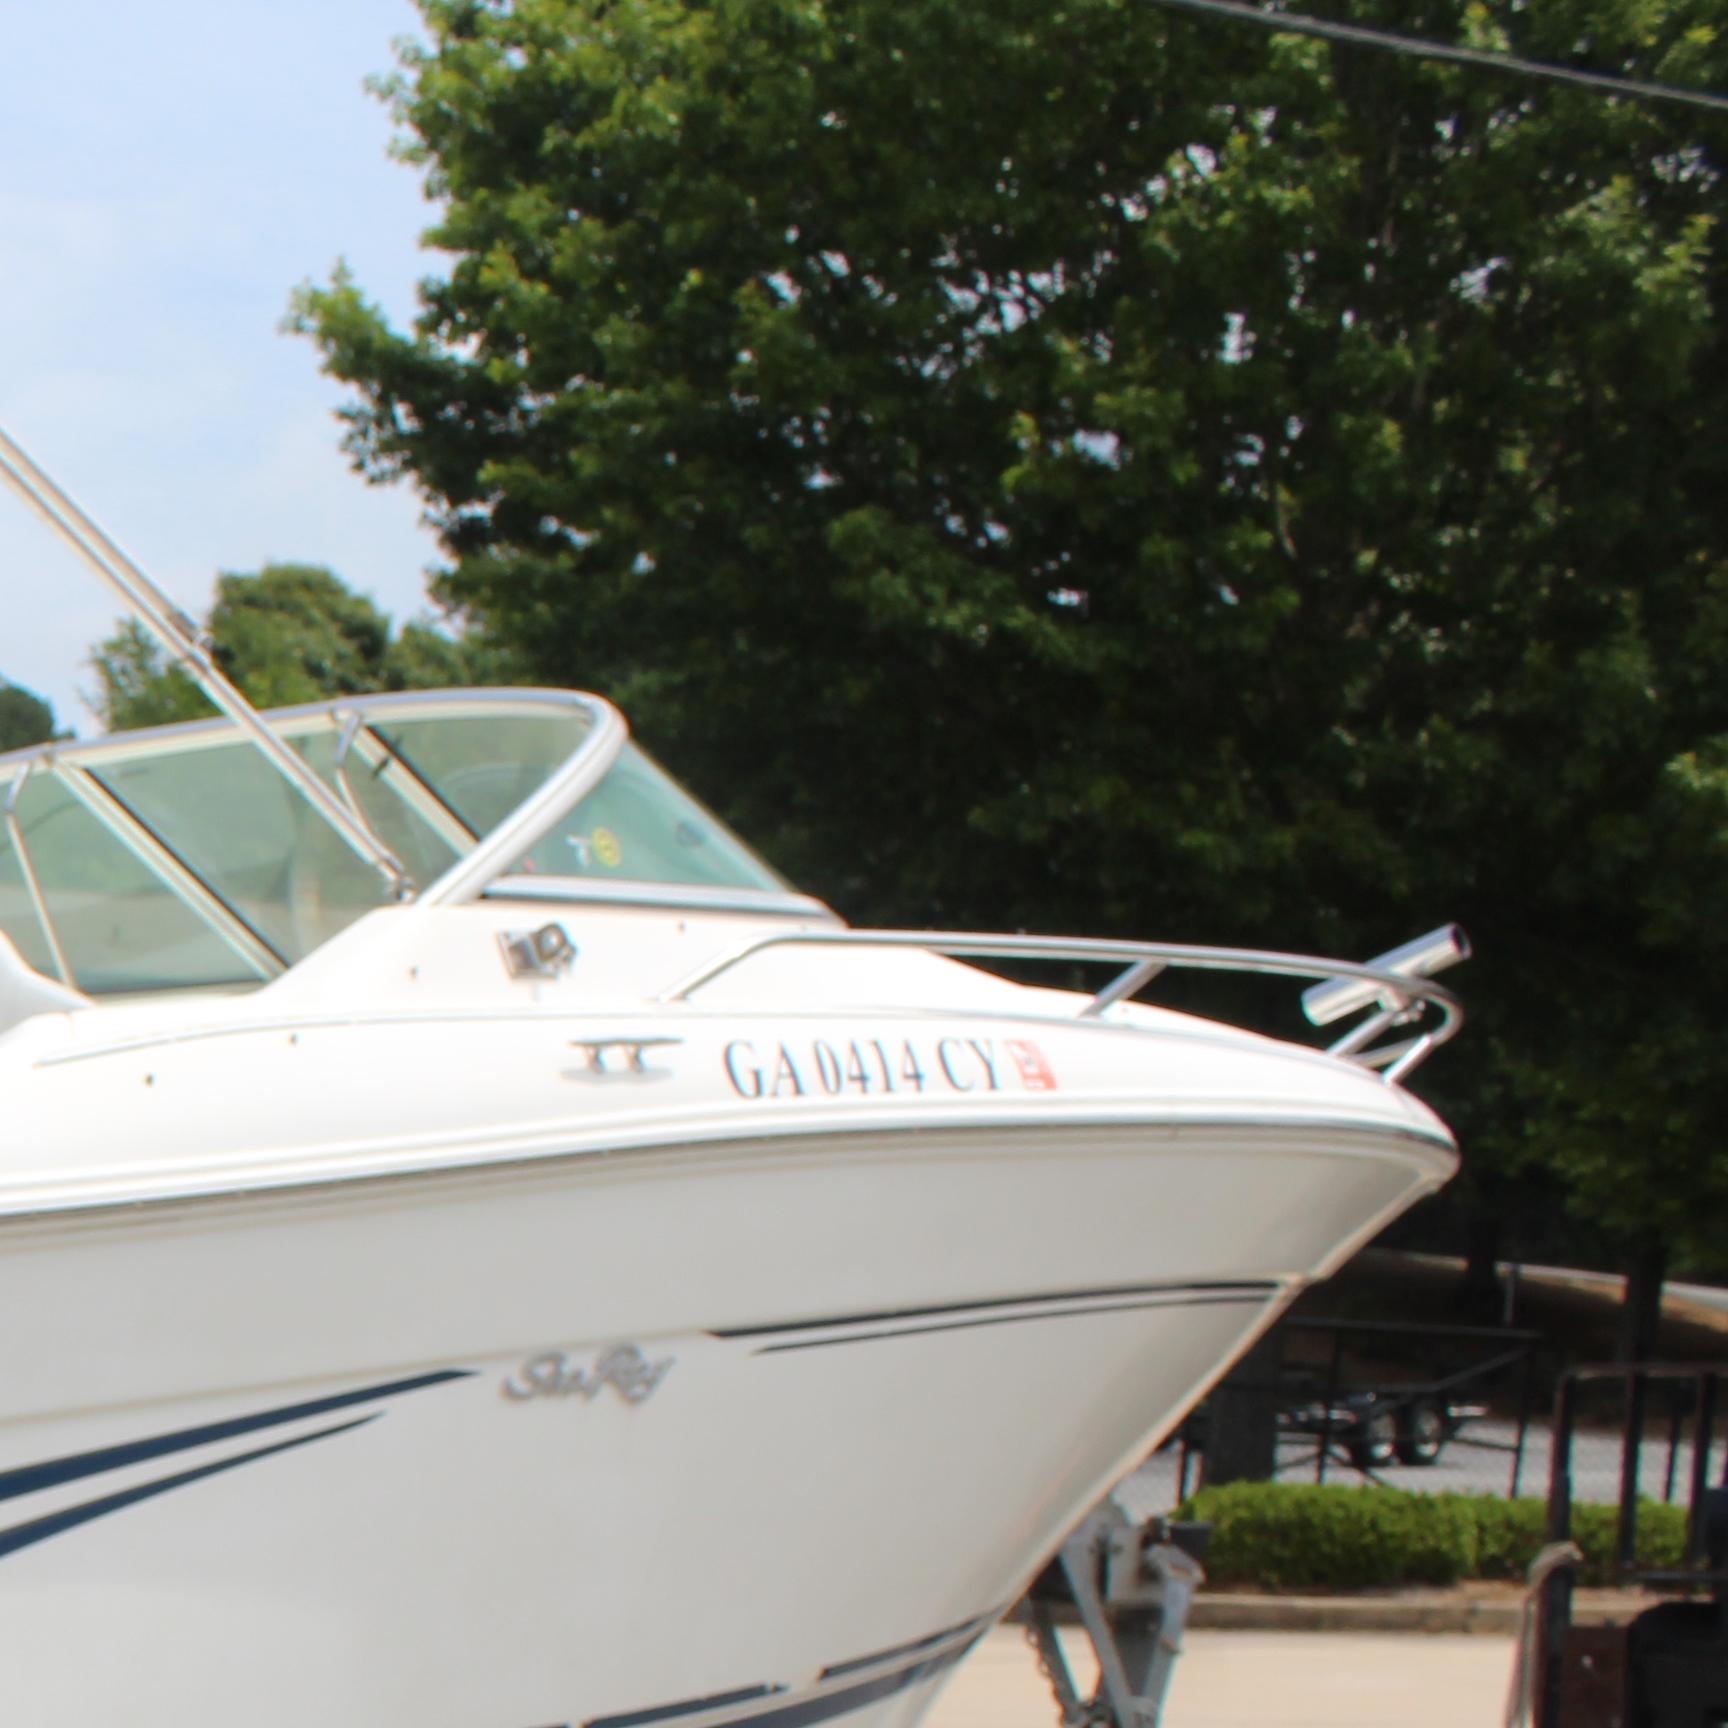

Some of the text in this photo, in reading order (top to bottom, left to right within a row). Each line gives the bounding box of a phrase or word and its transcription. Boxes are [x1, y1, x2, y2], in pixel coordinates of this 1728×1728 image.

[722, 1039, 804, 1099] GA
[813, 1039, 925, 1096] 0414
[936, 1038, 1000, 1092] CY
